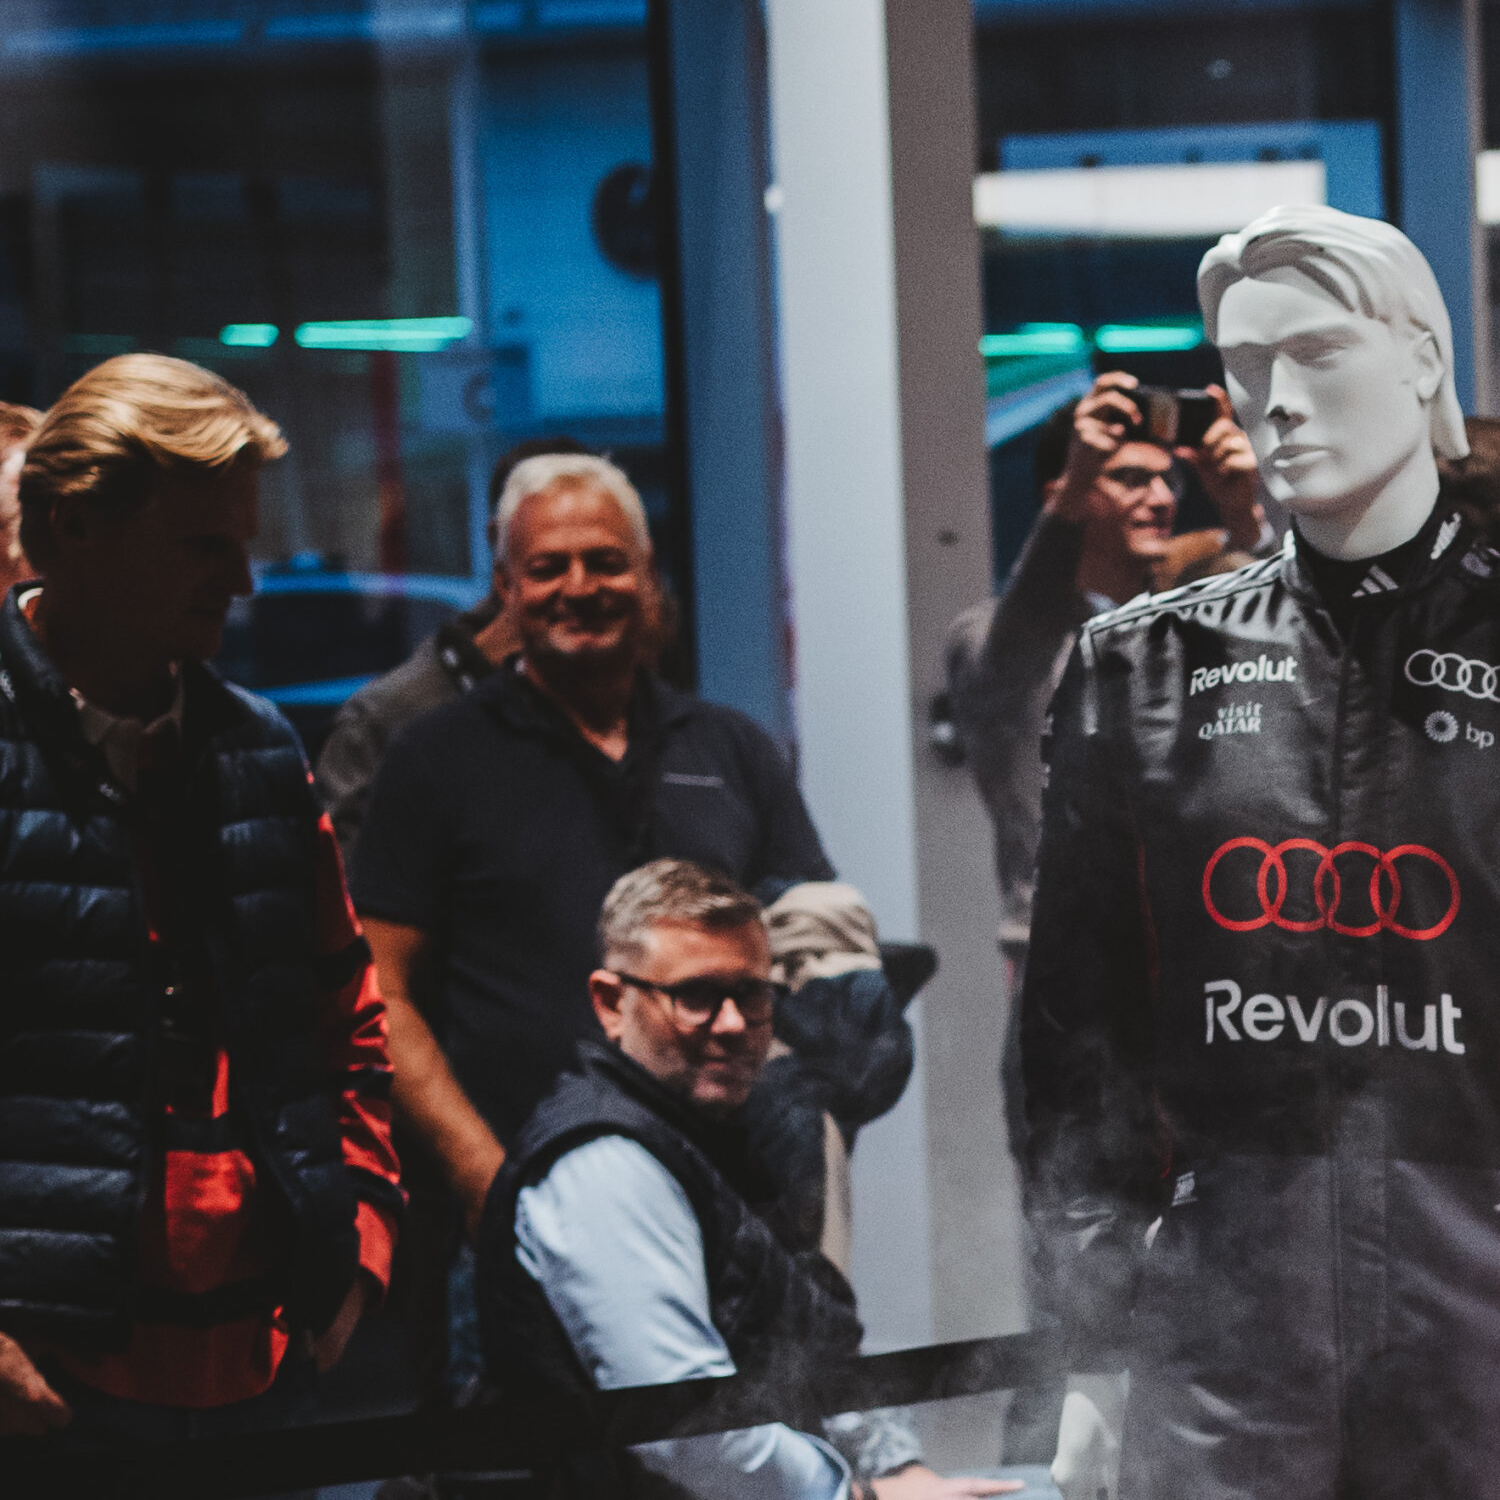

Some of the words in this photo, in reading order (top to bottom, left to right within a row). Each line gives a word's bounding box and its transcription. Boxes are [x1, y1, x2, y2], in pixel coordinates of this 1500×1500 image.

[1190, 655, 1298, 695] Revolut
[1198, 717, 1262, 740] QATAR
[1466, 723, 1494, 748] bp
[1205, 979, 1465, 1054] Revolut
